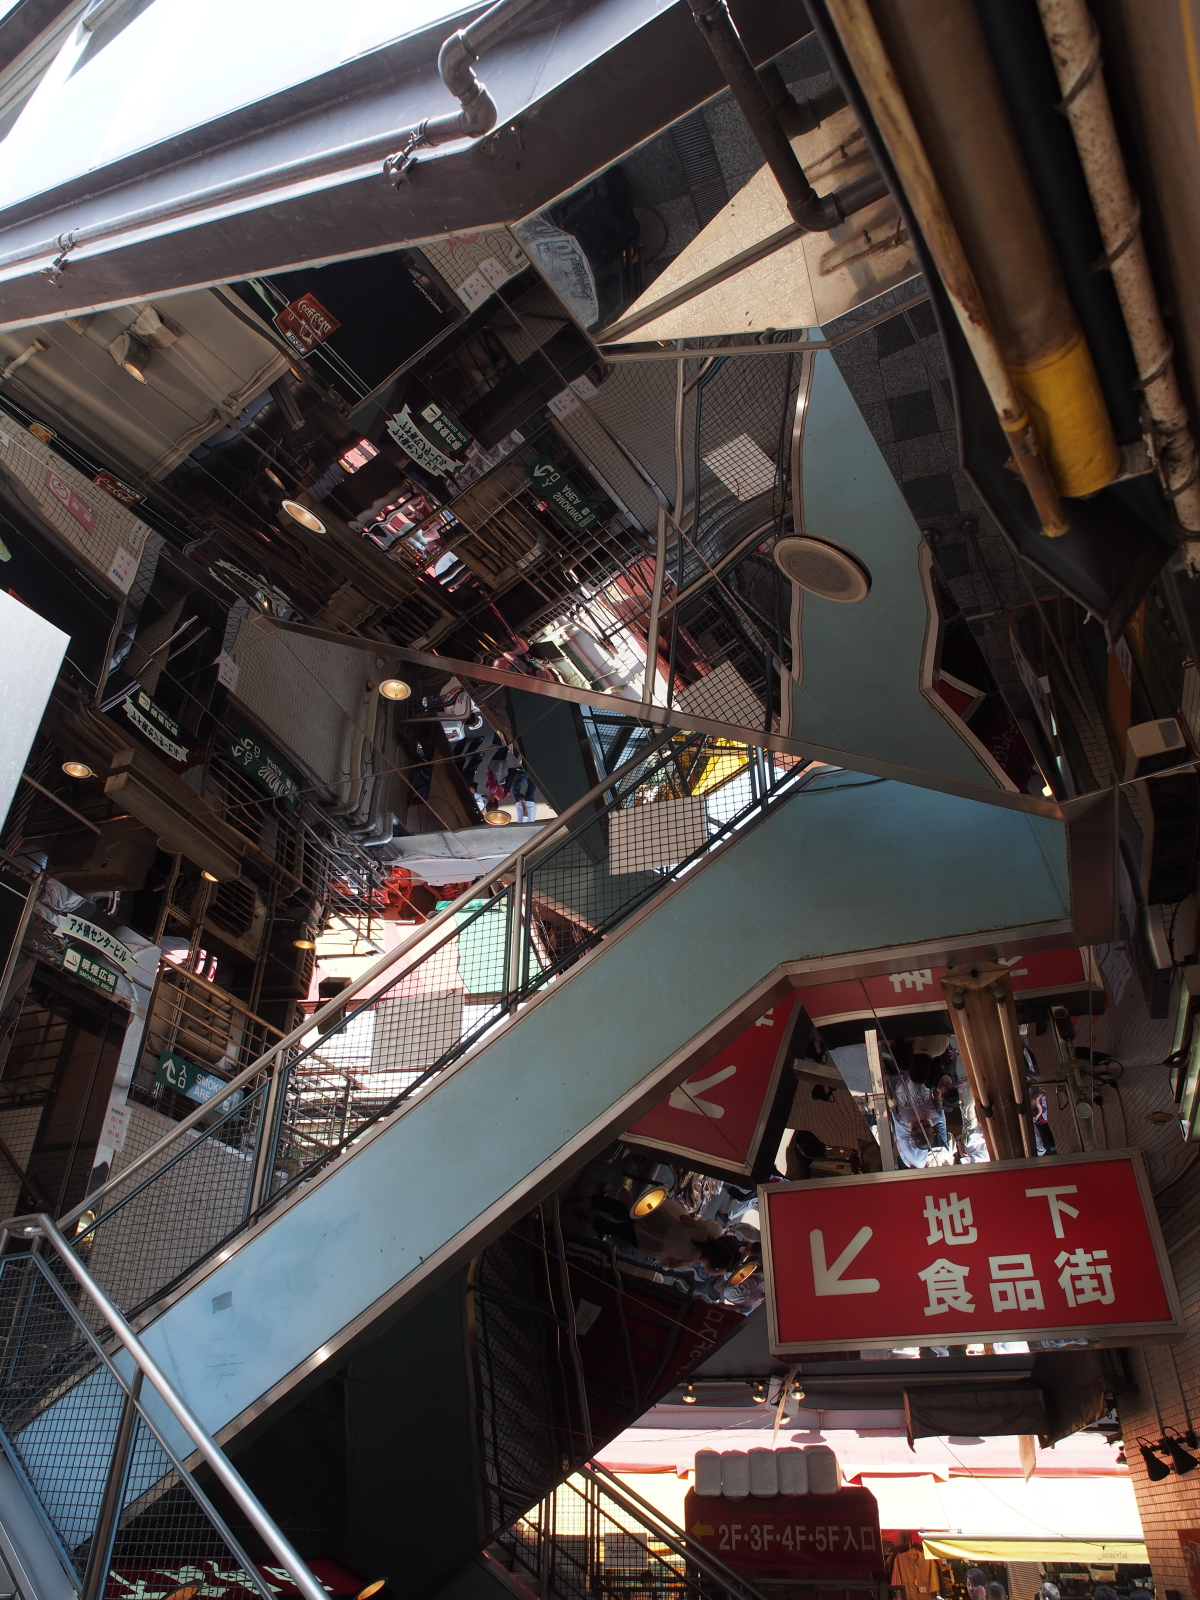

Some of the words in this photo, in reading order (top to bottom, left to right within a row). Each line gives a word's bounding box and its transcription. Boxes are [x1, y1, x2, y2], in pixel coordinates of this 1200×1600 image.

[69, 918, 127, 962] アメ横センタービル
[79, 970, 100, 987] SMOKING
[100, 982, 114, 993] AREA
[81, 957, 116, 987] 喫煙広場
[177, 1064, 188, 1089] 入口
[193, 1086, 211, 1101] ARE
[917, 1247, 1115, 1317] 食品街
[718, 1524, 876, 1552] 2F・3F・4F・5F入口
